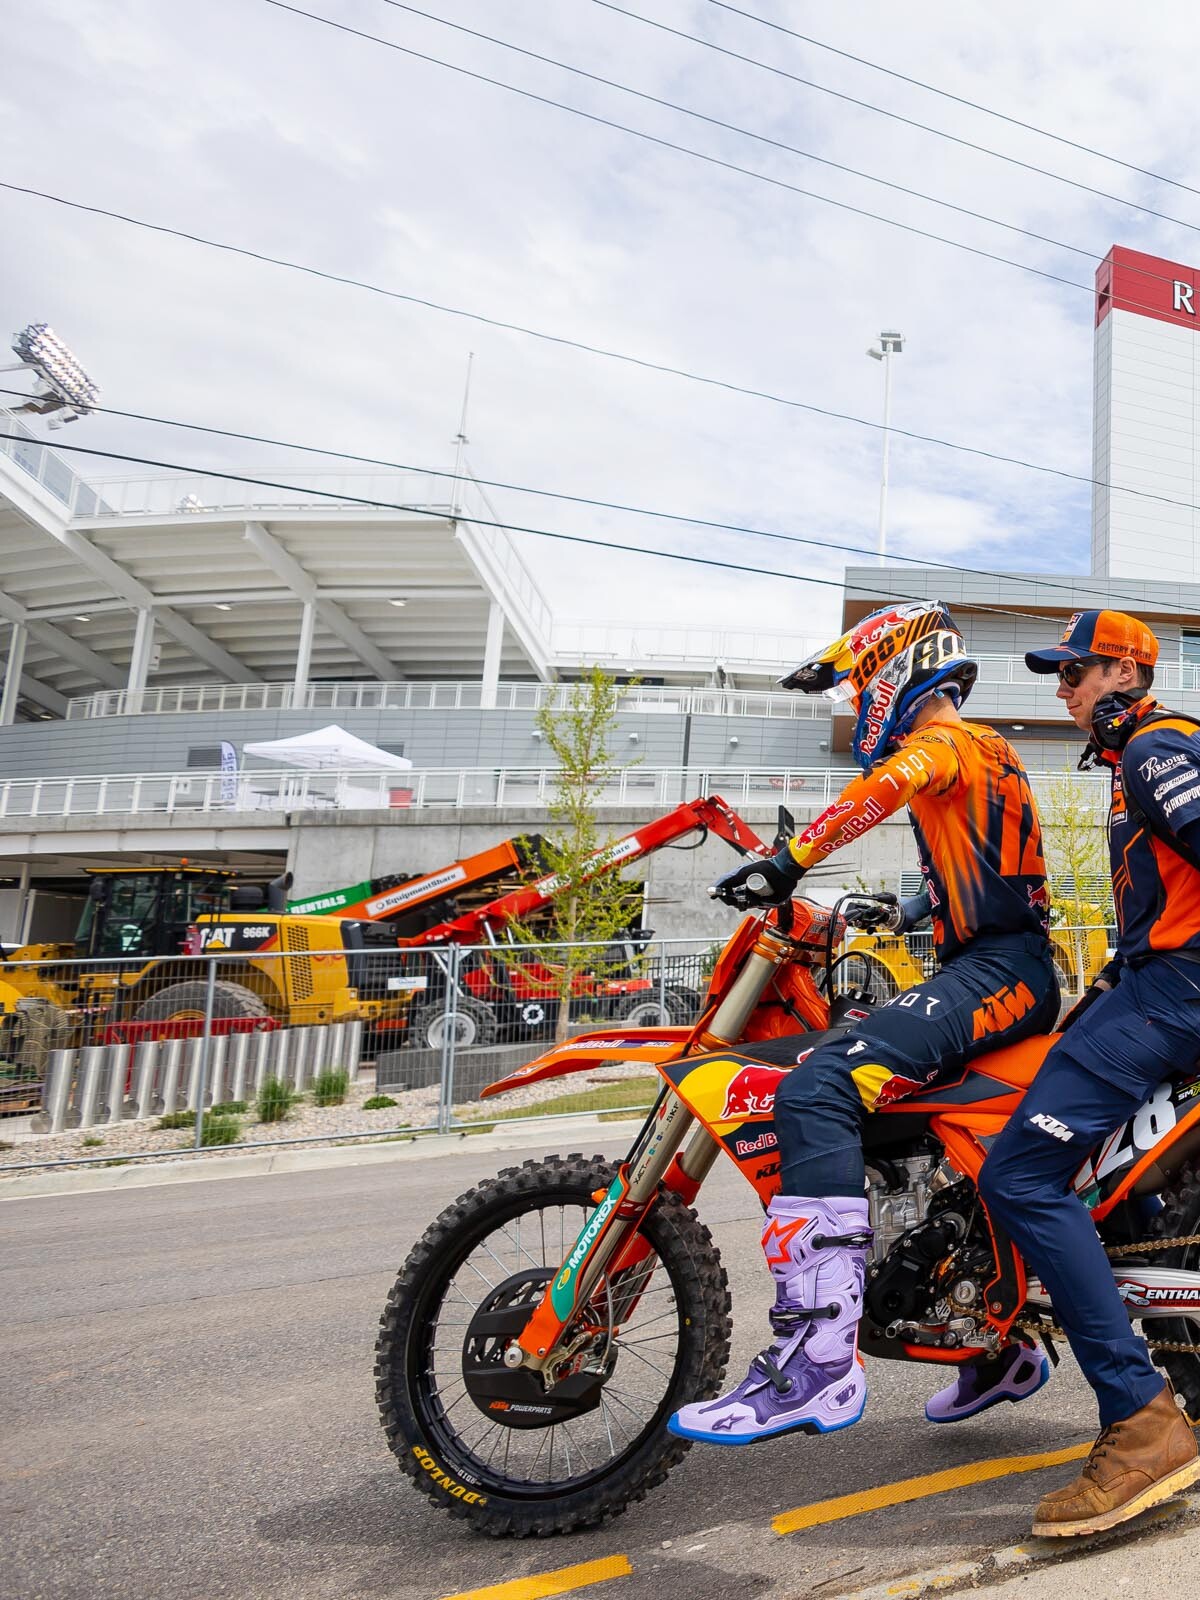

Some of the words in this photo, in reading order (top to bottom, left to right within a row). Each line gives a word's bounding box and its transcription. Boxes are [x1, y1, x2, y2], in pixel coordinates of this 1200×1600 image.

[1097, 642, 1129, 655] FACTORY
[290, 894, 347, 914] RENTALS
[385, 872, 457, 907] EquipmentShare
[200, 927, 236, 949] CAT
[243, 926, 271, 938] 966K
[972, 980, 1036, 1041] KTM
[1029, 1113, 1075, 1142] KTM
[568, 1194, 618, 1270] MOTOREX
[412, 1446, 482, 1504] DUNLOP
